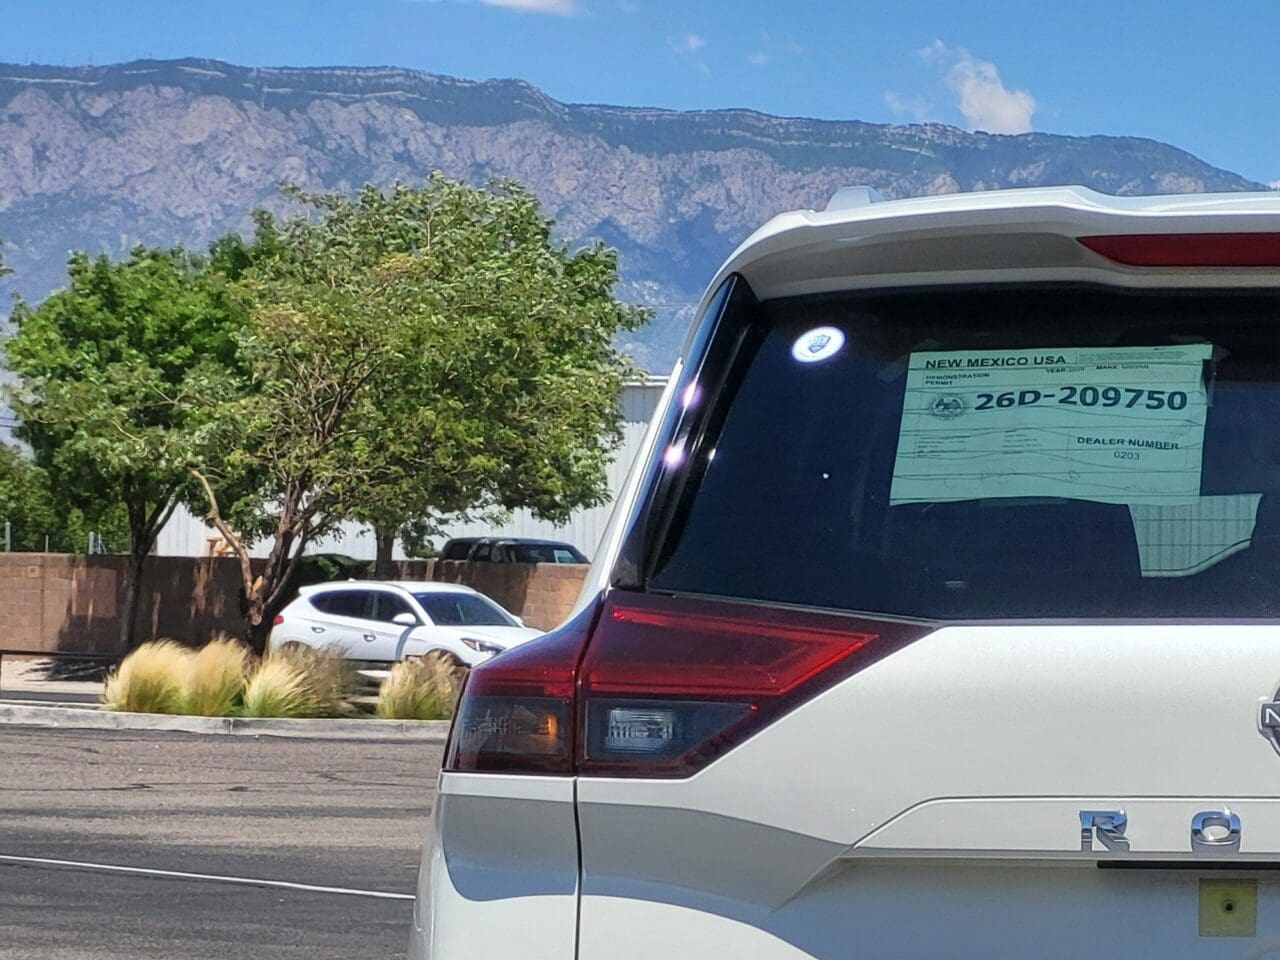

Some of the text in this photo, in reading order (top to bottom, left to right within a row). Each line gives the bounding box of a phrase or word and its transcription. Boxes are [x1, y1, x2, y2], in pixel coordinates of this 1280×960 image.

[925, 356, 1067, 369] NEW MEXICO USA
[974, 386, 1188, 411] 26D-209750
[1077, 437, 1180, 450] DEALER NUMBER
[1113, 451, 1140, 460] 0203
